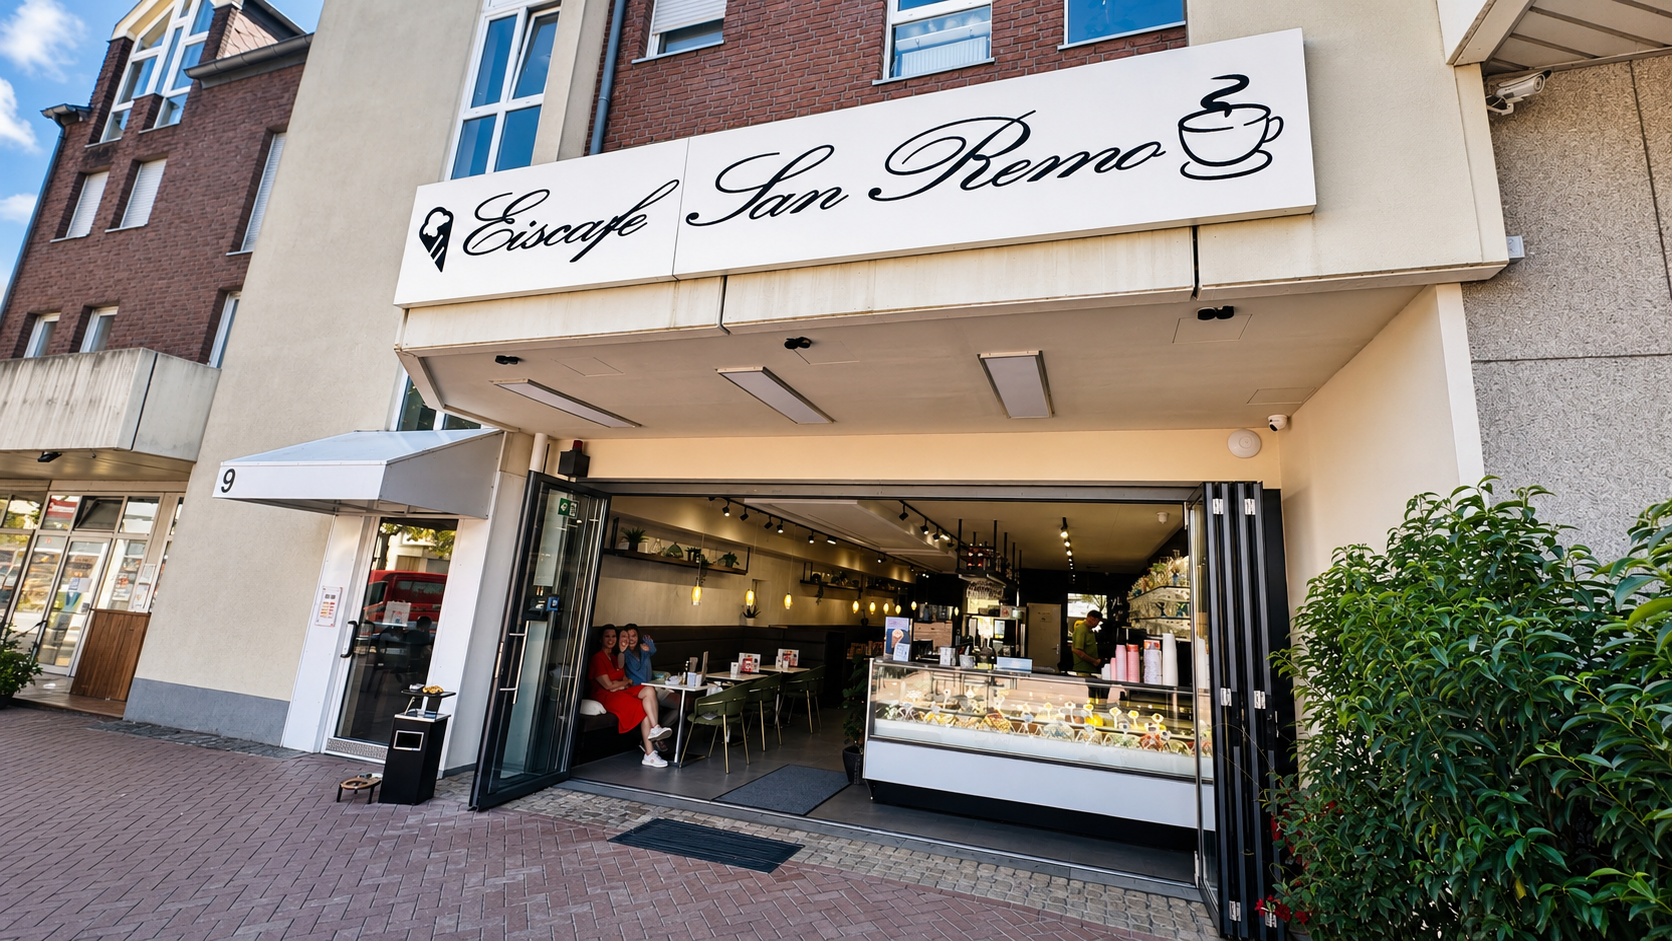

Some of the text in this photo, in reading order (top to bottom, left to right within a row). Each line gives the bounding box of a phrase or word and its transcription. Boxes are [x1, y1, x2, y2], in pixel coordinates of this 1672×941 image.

[463, 110, 1167, 263] Eiscafe San Remo
[220, 468, 236, 494] 9
